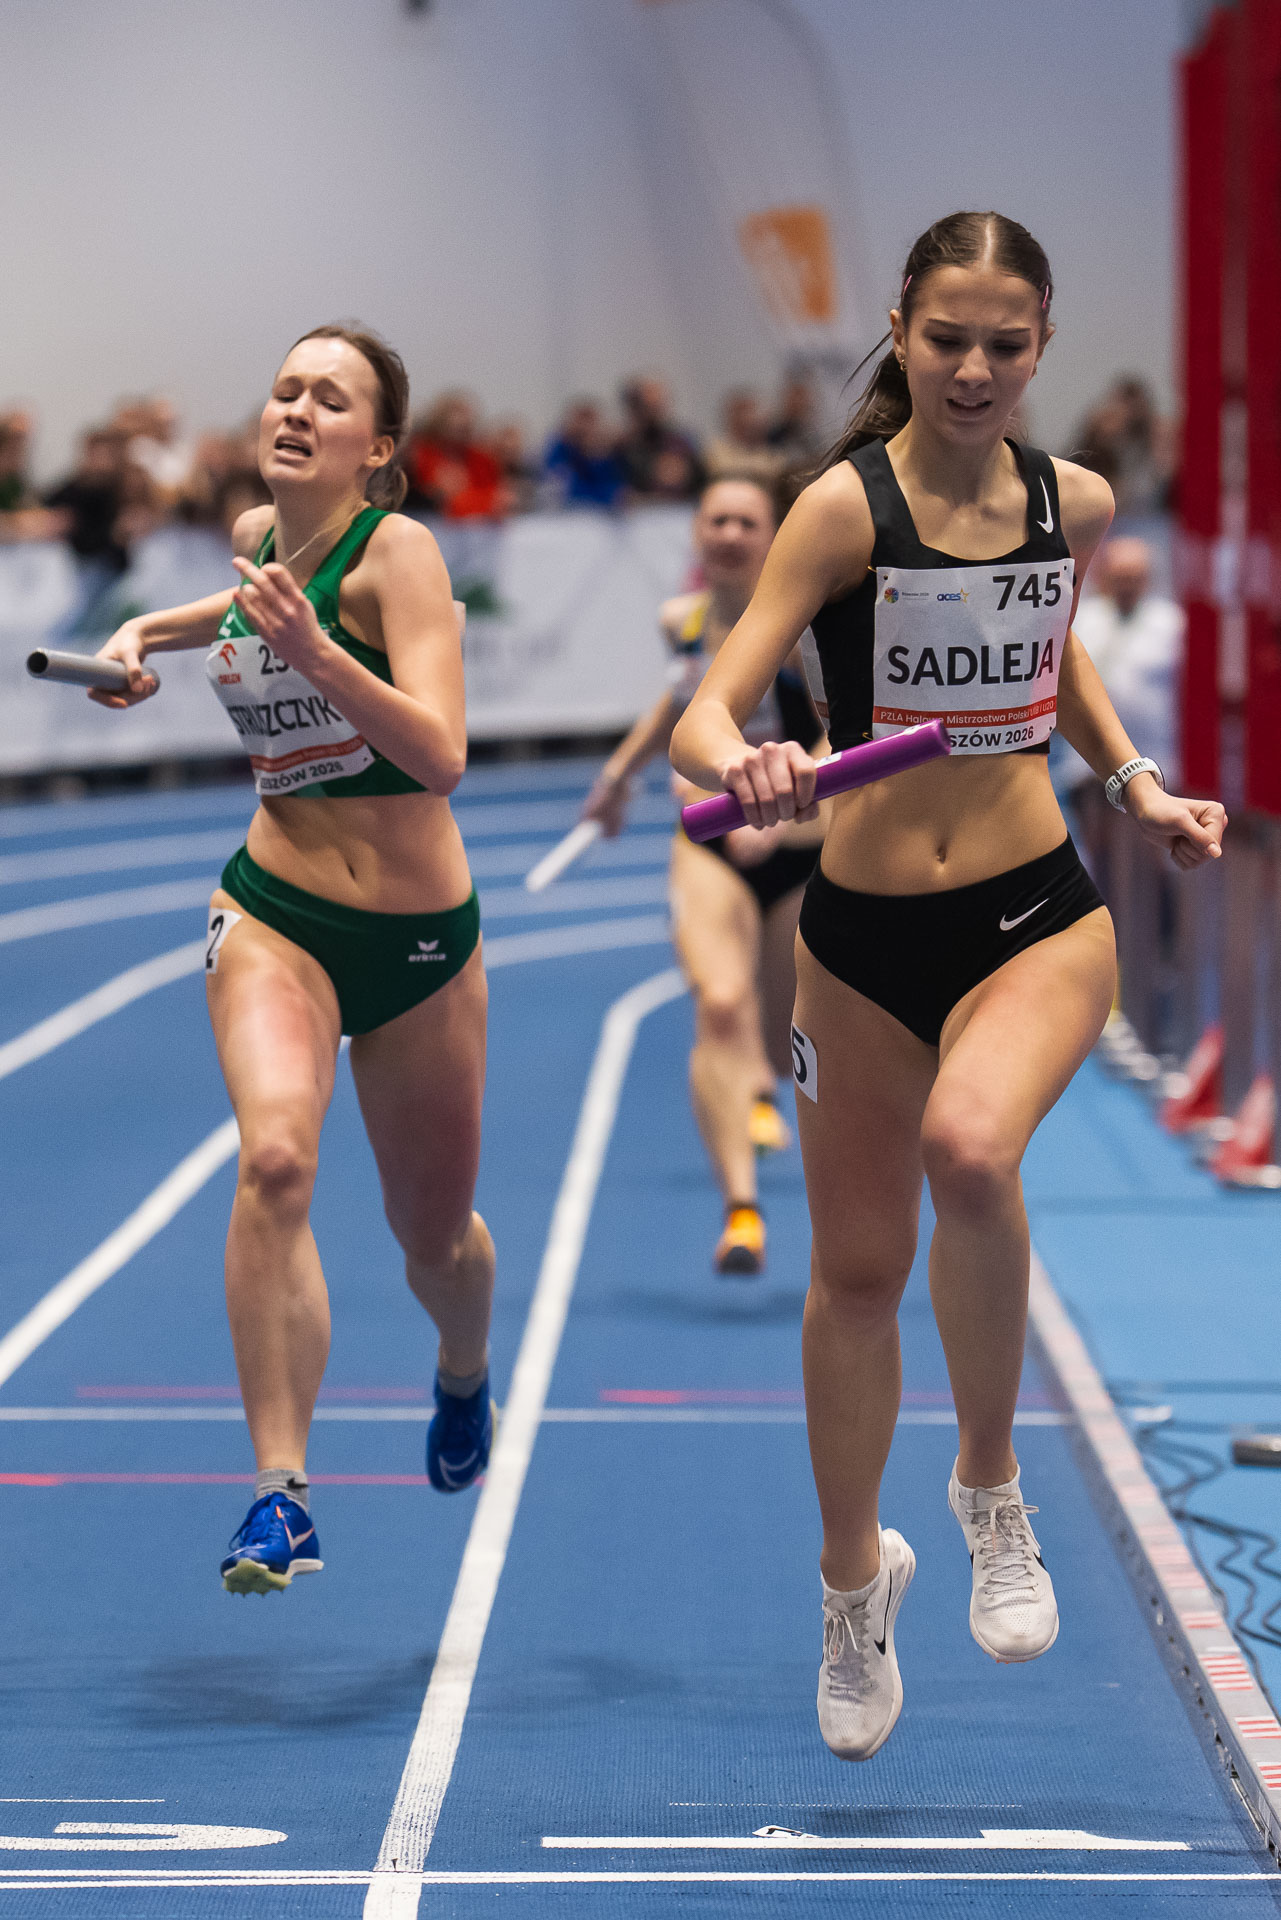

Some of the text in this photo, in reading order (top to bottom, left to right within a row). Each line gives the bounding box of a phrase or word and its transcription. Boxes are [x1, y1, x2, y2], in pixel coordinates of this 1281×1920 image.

[937, 593, 961, 601] aces
[993, 572, 1061, 610] 745
[887, 638, 1054, 686] SADLEJA
[880, 711, 904, 722] PZLA
[905, 714, 944, 723] Haloe
[946, 713, 1006, 724] Mistrzostwa
[1008, 710, 1029, 721] Polski
[1043, 700, 1054, 711] U20
[950, 726, 1035, 748] SZÓW 2026
[309, 761, 344, 778] 2026
[205, 914, 225, 970] 2
[408, 952, 447, 963] erima
[792, 1026, 807, 1084] 5
